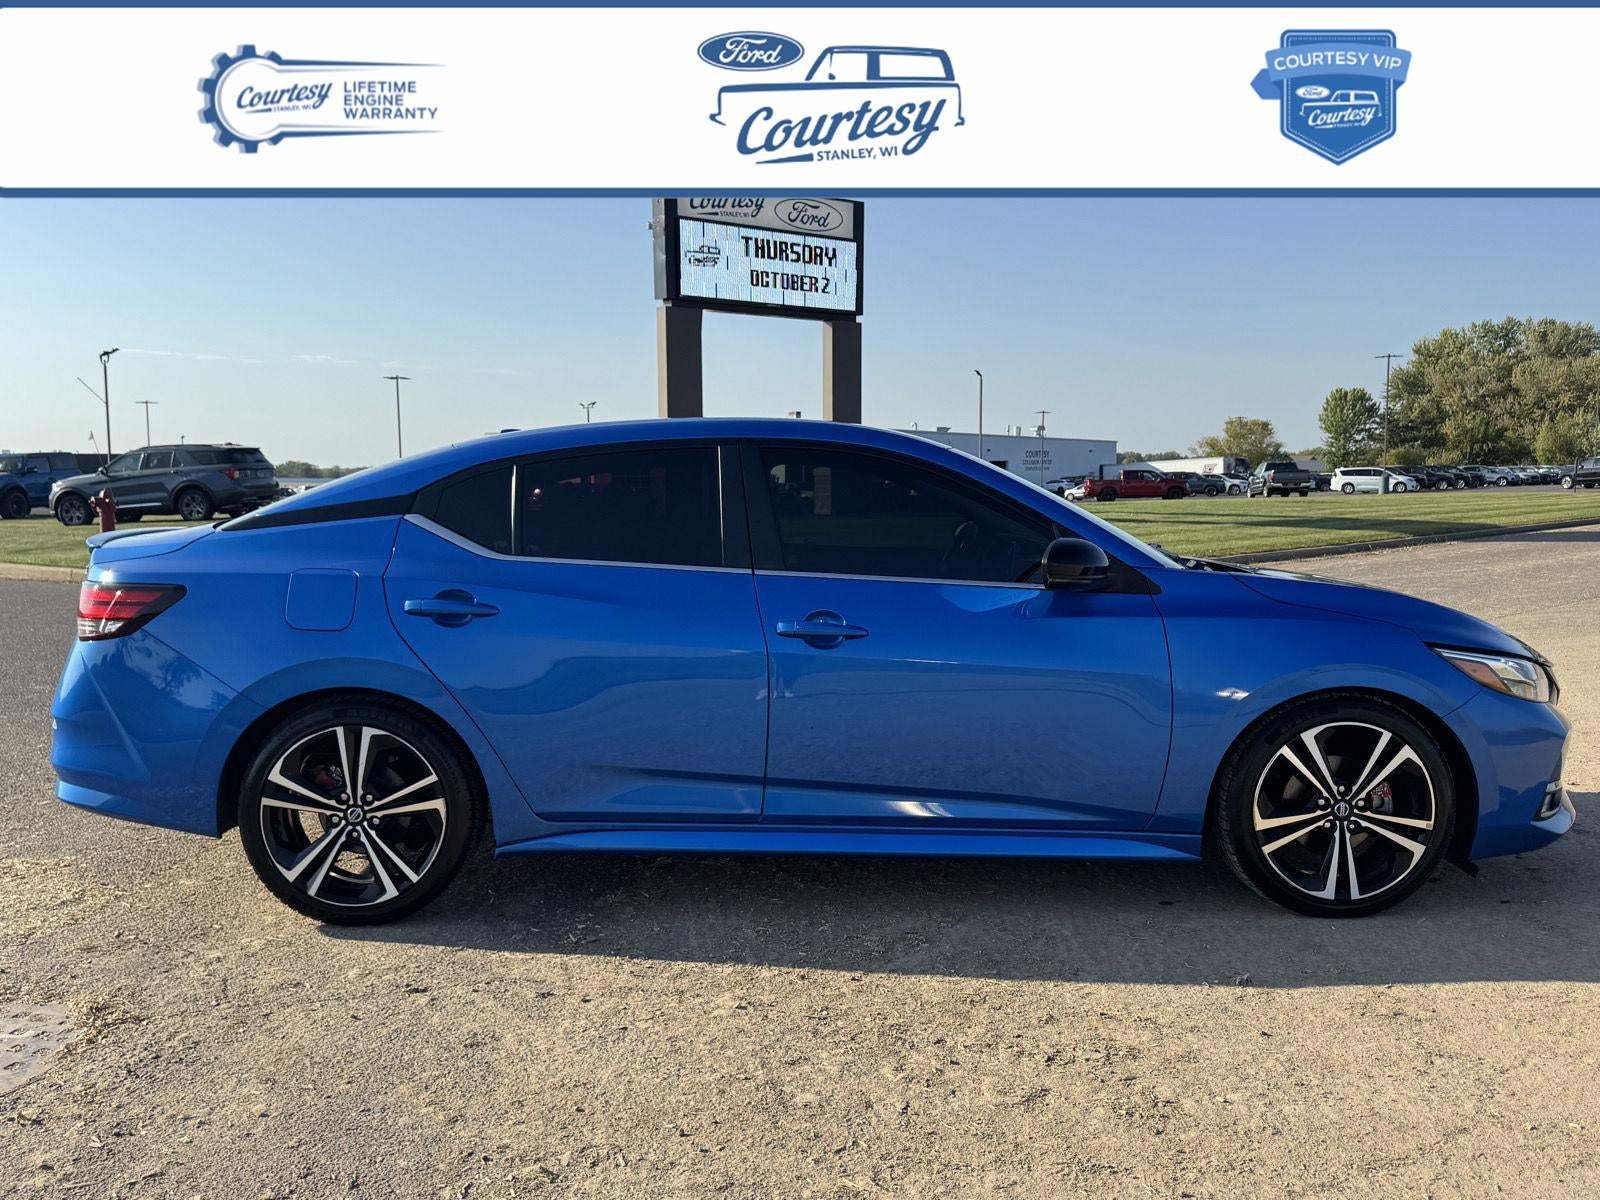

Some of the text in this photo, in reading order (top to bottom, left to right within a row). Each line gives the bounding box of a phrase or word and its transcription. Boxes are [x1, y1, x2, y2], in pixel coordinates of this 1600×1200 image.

[788, 201, 831, 228] Ford
[741, 236, 837, 267] THURSDAY
[750, 269, 831, 294] OCTOBER 2
[1025, 450, 1049, 458] COURTSY
